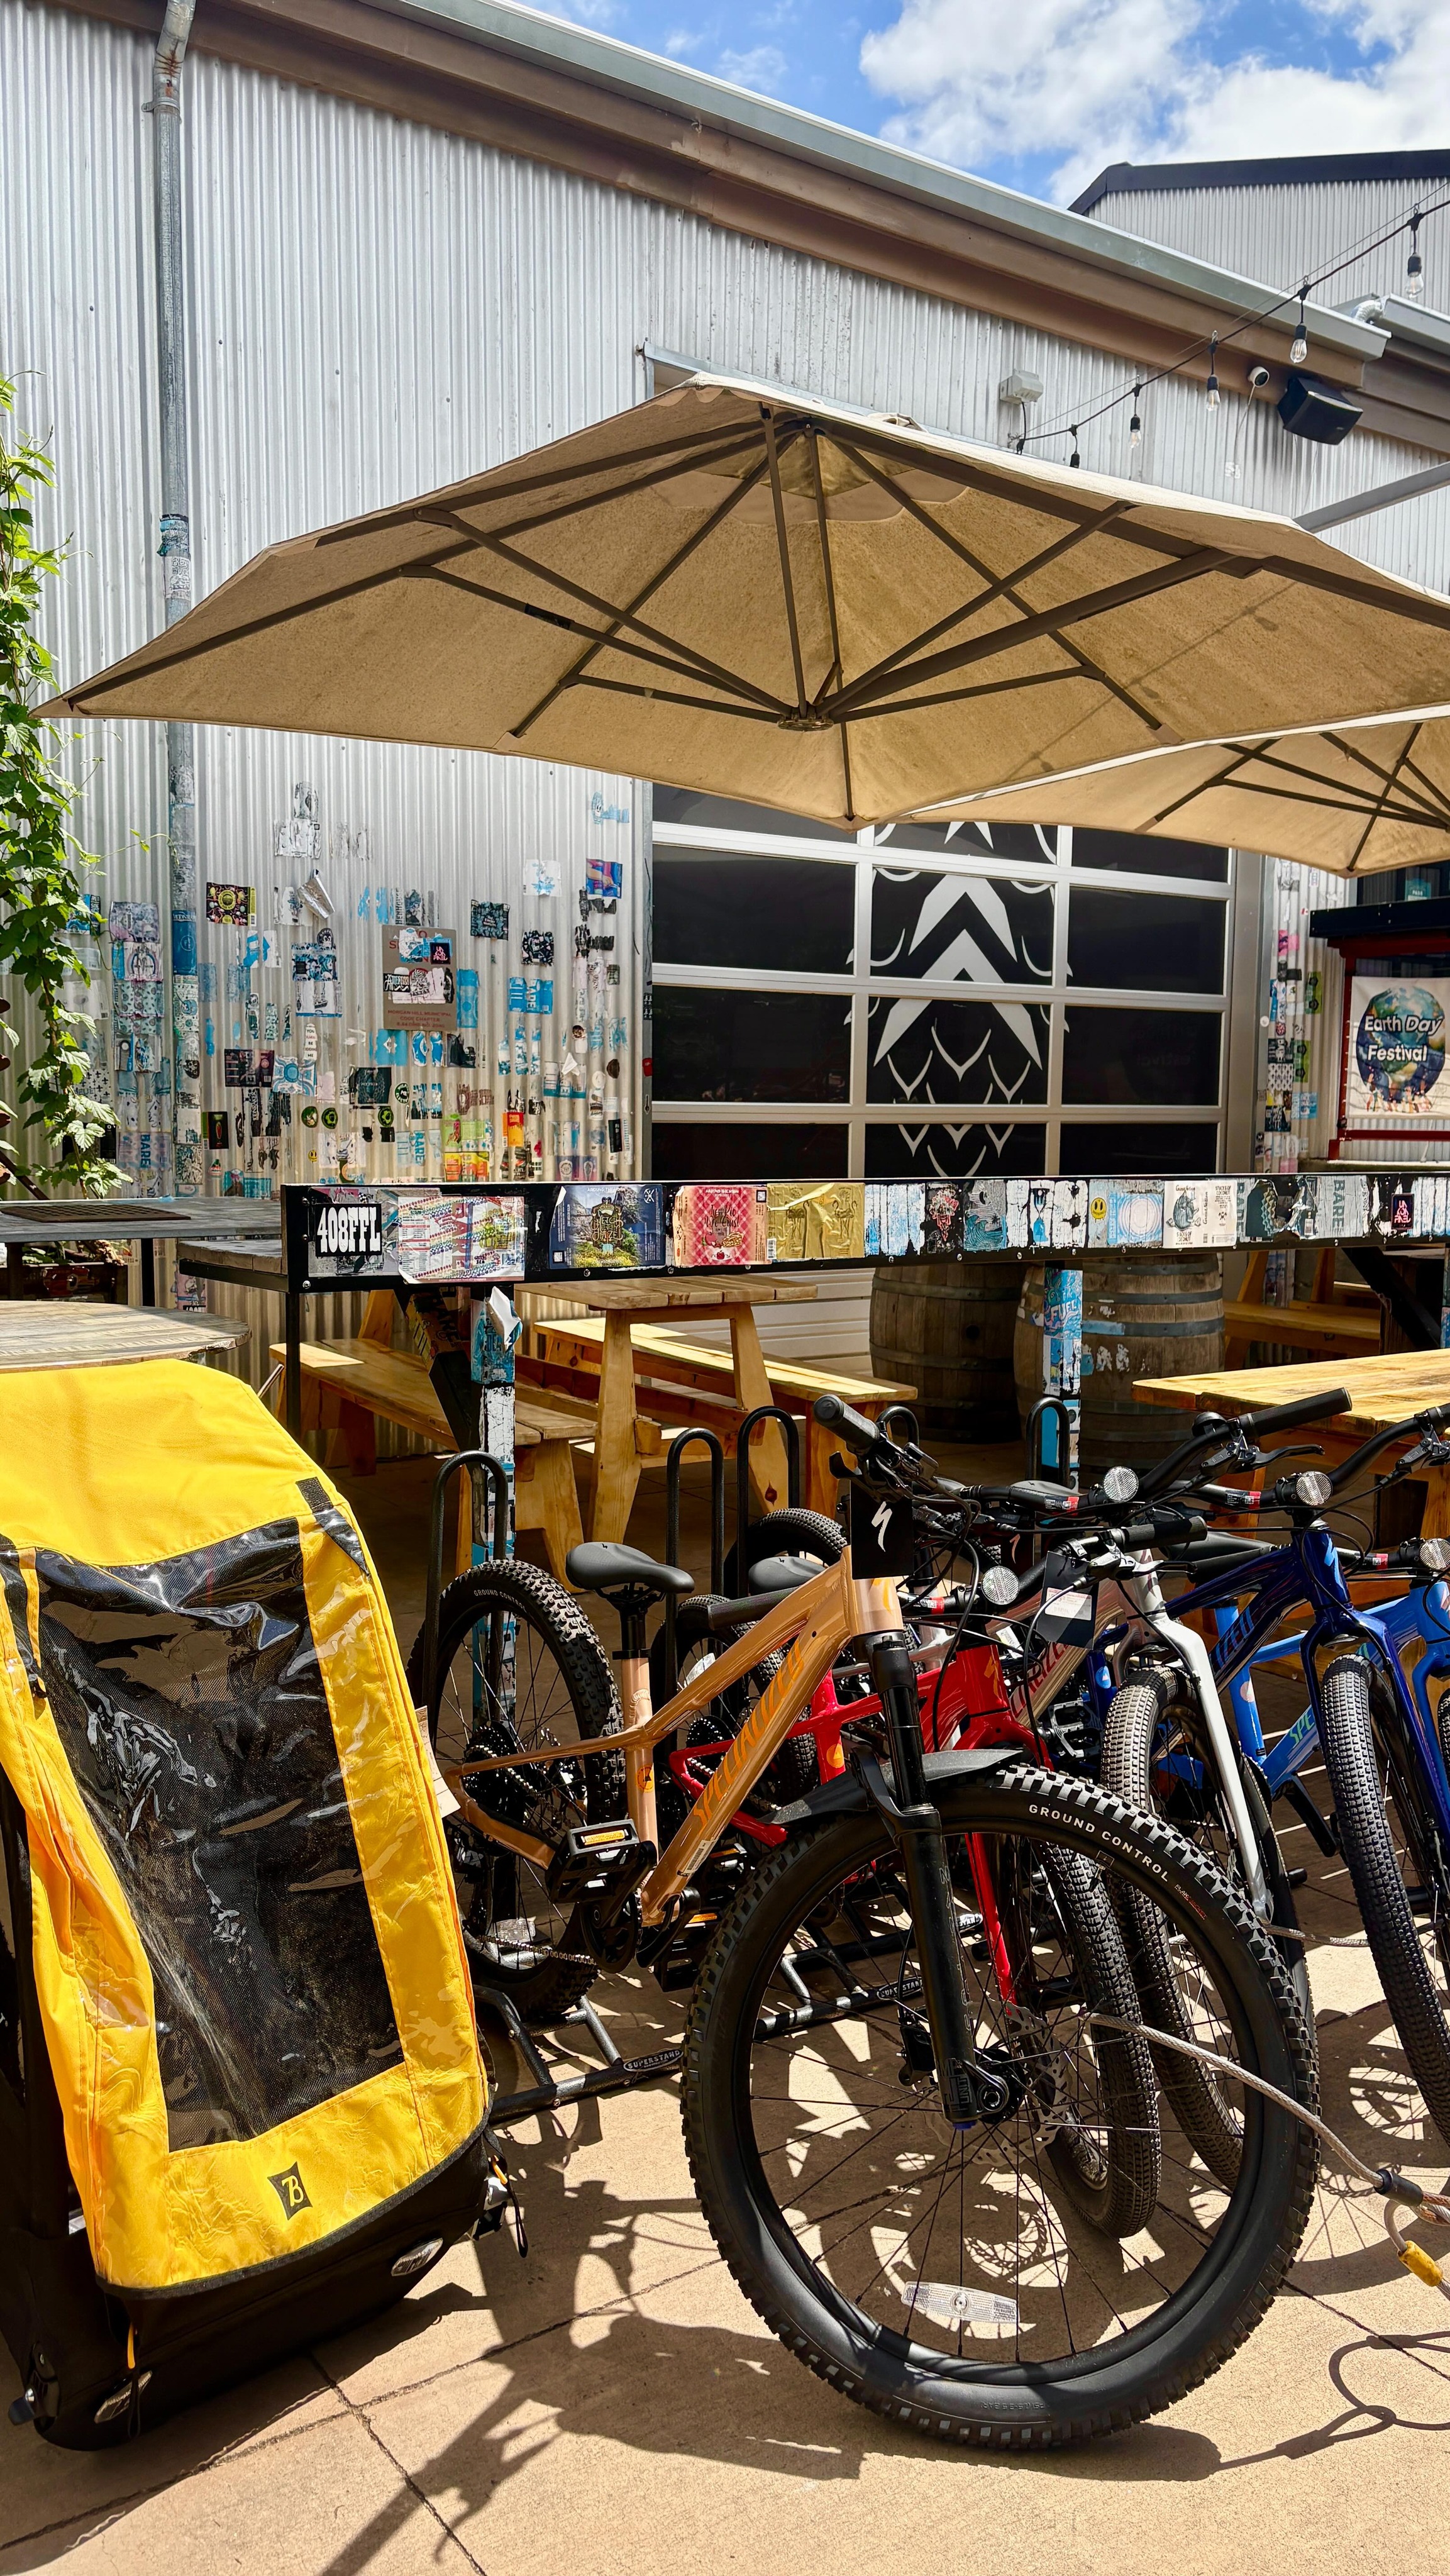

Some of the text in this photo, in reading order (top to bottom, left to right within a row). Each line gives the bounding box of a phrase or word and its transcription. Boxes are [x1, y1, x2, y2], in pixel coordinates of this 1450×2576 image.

[1364, 1015, 1444, 1036] Earth Day
[1367, 1044, 1427, 1062] Festival
[141, 1134, 151, 1168] BARE
[415, 1131, 425, 1163] BARE
[1332, 1180, 1345, 1229] BARE
[317, 1206, 380, 1253] 408FFL
[499, 1591, 526, 1613] CONTROL
[693, 1639, 804, 1835] SPECIALIZED
[1029, 1804, 1169, 1882] GROUND CONTROL
[628, 2050, 680, 2069] SUPERSTAND
